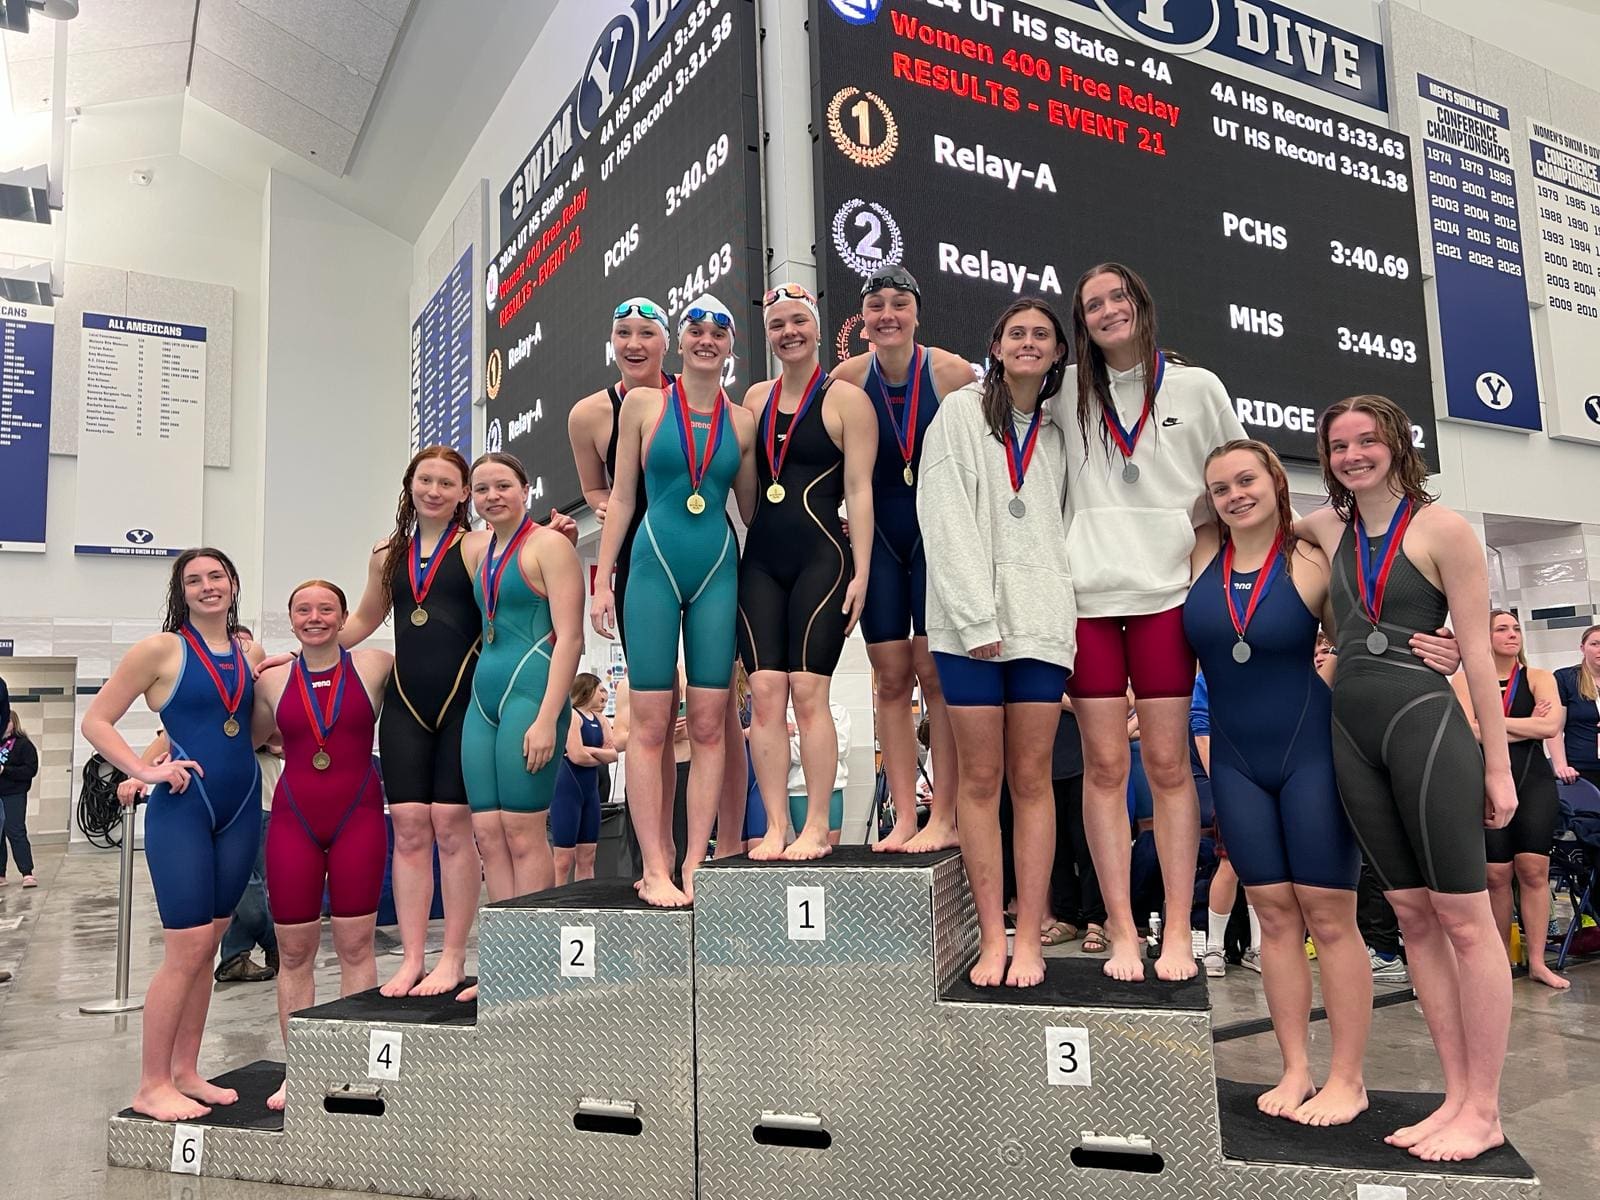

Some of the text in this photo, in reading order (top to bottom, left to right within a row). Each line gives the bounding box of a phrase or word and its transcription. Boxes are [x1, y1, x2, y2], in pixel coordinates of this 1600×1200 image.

[970, 0, 1005, 27] UT
[1013, 14, 1047, 41] HS
[1055, 26, 1118, 66] State
[1142, 57, 1173, 85] 4A
[1235, 0, 1361, 89] DIVE
[890, 9, 1180, 127] Women 400 Free Relay
[600, 120, 614, 144] 4A
[615, 97, 631, 129] HS
[632, 42, 672, 108] Record
[601, 12, 731, 181] UT HS Record 3:31.38
[893, 52, 1020, 112] RESULTS
[1048, 99, 1128, 143] EVENT
[1138, 127, 1166, 155] 21
[1429, 82, 1453, 102] MEN'S
[1454, 92, 1476, 111] SWIM
[1482, 103, 1500, 120] DIVE
[511, 27, 623, 220] SWIM Y
[1210, 82, 1404, 160] 4A HS Record 3:33.63
[1437, 106, 1498, 143] CONFERENCE
[1533, 123, 1563, 146] WOMEN'S
[1564, 136, 1583, 154] SWIM
[851, 100, 1057, 192] 1 Relay-A
[1212, 117, 1408, 192] UT HS Record 3:31.38
[1427, 120, 1510, 164] CHAMPIONSHIPS
[665, 134, 728, 216] 3:40.69
[1427, 147, 1513, 186] 1974 1979 1996
[1544, 146, 1599, 180] CONFERENCE
[1429, 170, 1515, 209] 2000 2001 2002
[1538, 185, 1559, 202] 1979
[1565, 195, 1586, 211] 1985
[499, 240, 516, 273] 2024
[517, 225, 527, 249] UT
[529, 211, 540, 236] HS
[541, 185, 563, 221] State
[571, 156, 584, 183] 4A
[1431, 195, 1517, 231] 2003 2004 2012
[1540, 207, 1562, 224] 1988
[1567, 216, 1589, 233] 1990
[499, 187, 588, 300] Women 400 Free Relay
[604, 223, 639, 277] PCHS
[855, 211, 1062, 295] 2 Relay-A
[1223, 212, 1409, 280] PCHS 3:40.69
[1433, 218, 1519, 254] 2014 2015 2016
[1542, 229, 1565, 246] 1993
[1570, 238, 1591, 254] 1994
[499, 280, 532, 328] RESULTS
[538, 240, 567, 286] EVENT
[569, 225, 582, 254] 21
[668, 243, 731, 316] 3:44.93
[1436, 243, 1522, 277] 2021 2022 2023
[1544, 251, 1568, 268] 2000
[1572, 260, 1593, 276] 2001
[1547, 274, 1596, 297] 2003 2004
[1, 306, 28, 318] CANS
[1549, 296, 1598, 318] 2009 2010
[108, 319, 182, 337] ALL AMERICANS
[508, 321, 542, 370] Relay-A
[1230, 304, 1417, 363] MHS 3:44.93
[1482, 376, 1506, 406] Y
[508, 399, 543, 442] Relay-A
[1237, 398, 1315, 432] RIDGE
[130, 531, 149, 542] Y
[799, 900, 813, 929] 1
[569, 939, 585, 967] 2
[376, 1042, 393, 1069] 4
[1059, 1041, 1078, 1073] 3
[181, 1138, 196, 1164] 6
